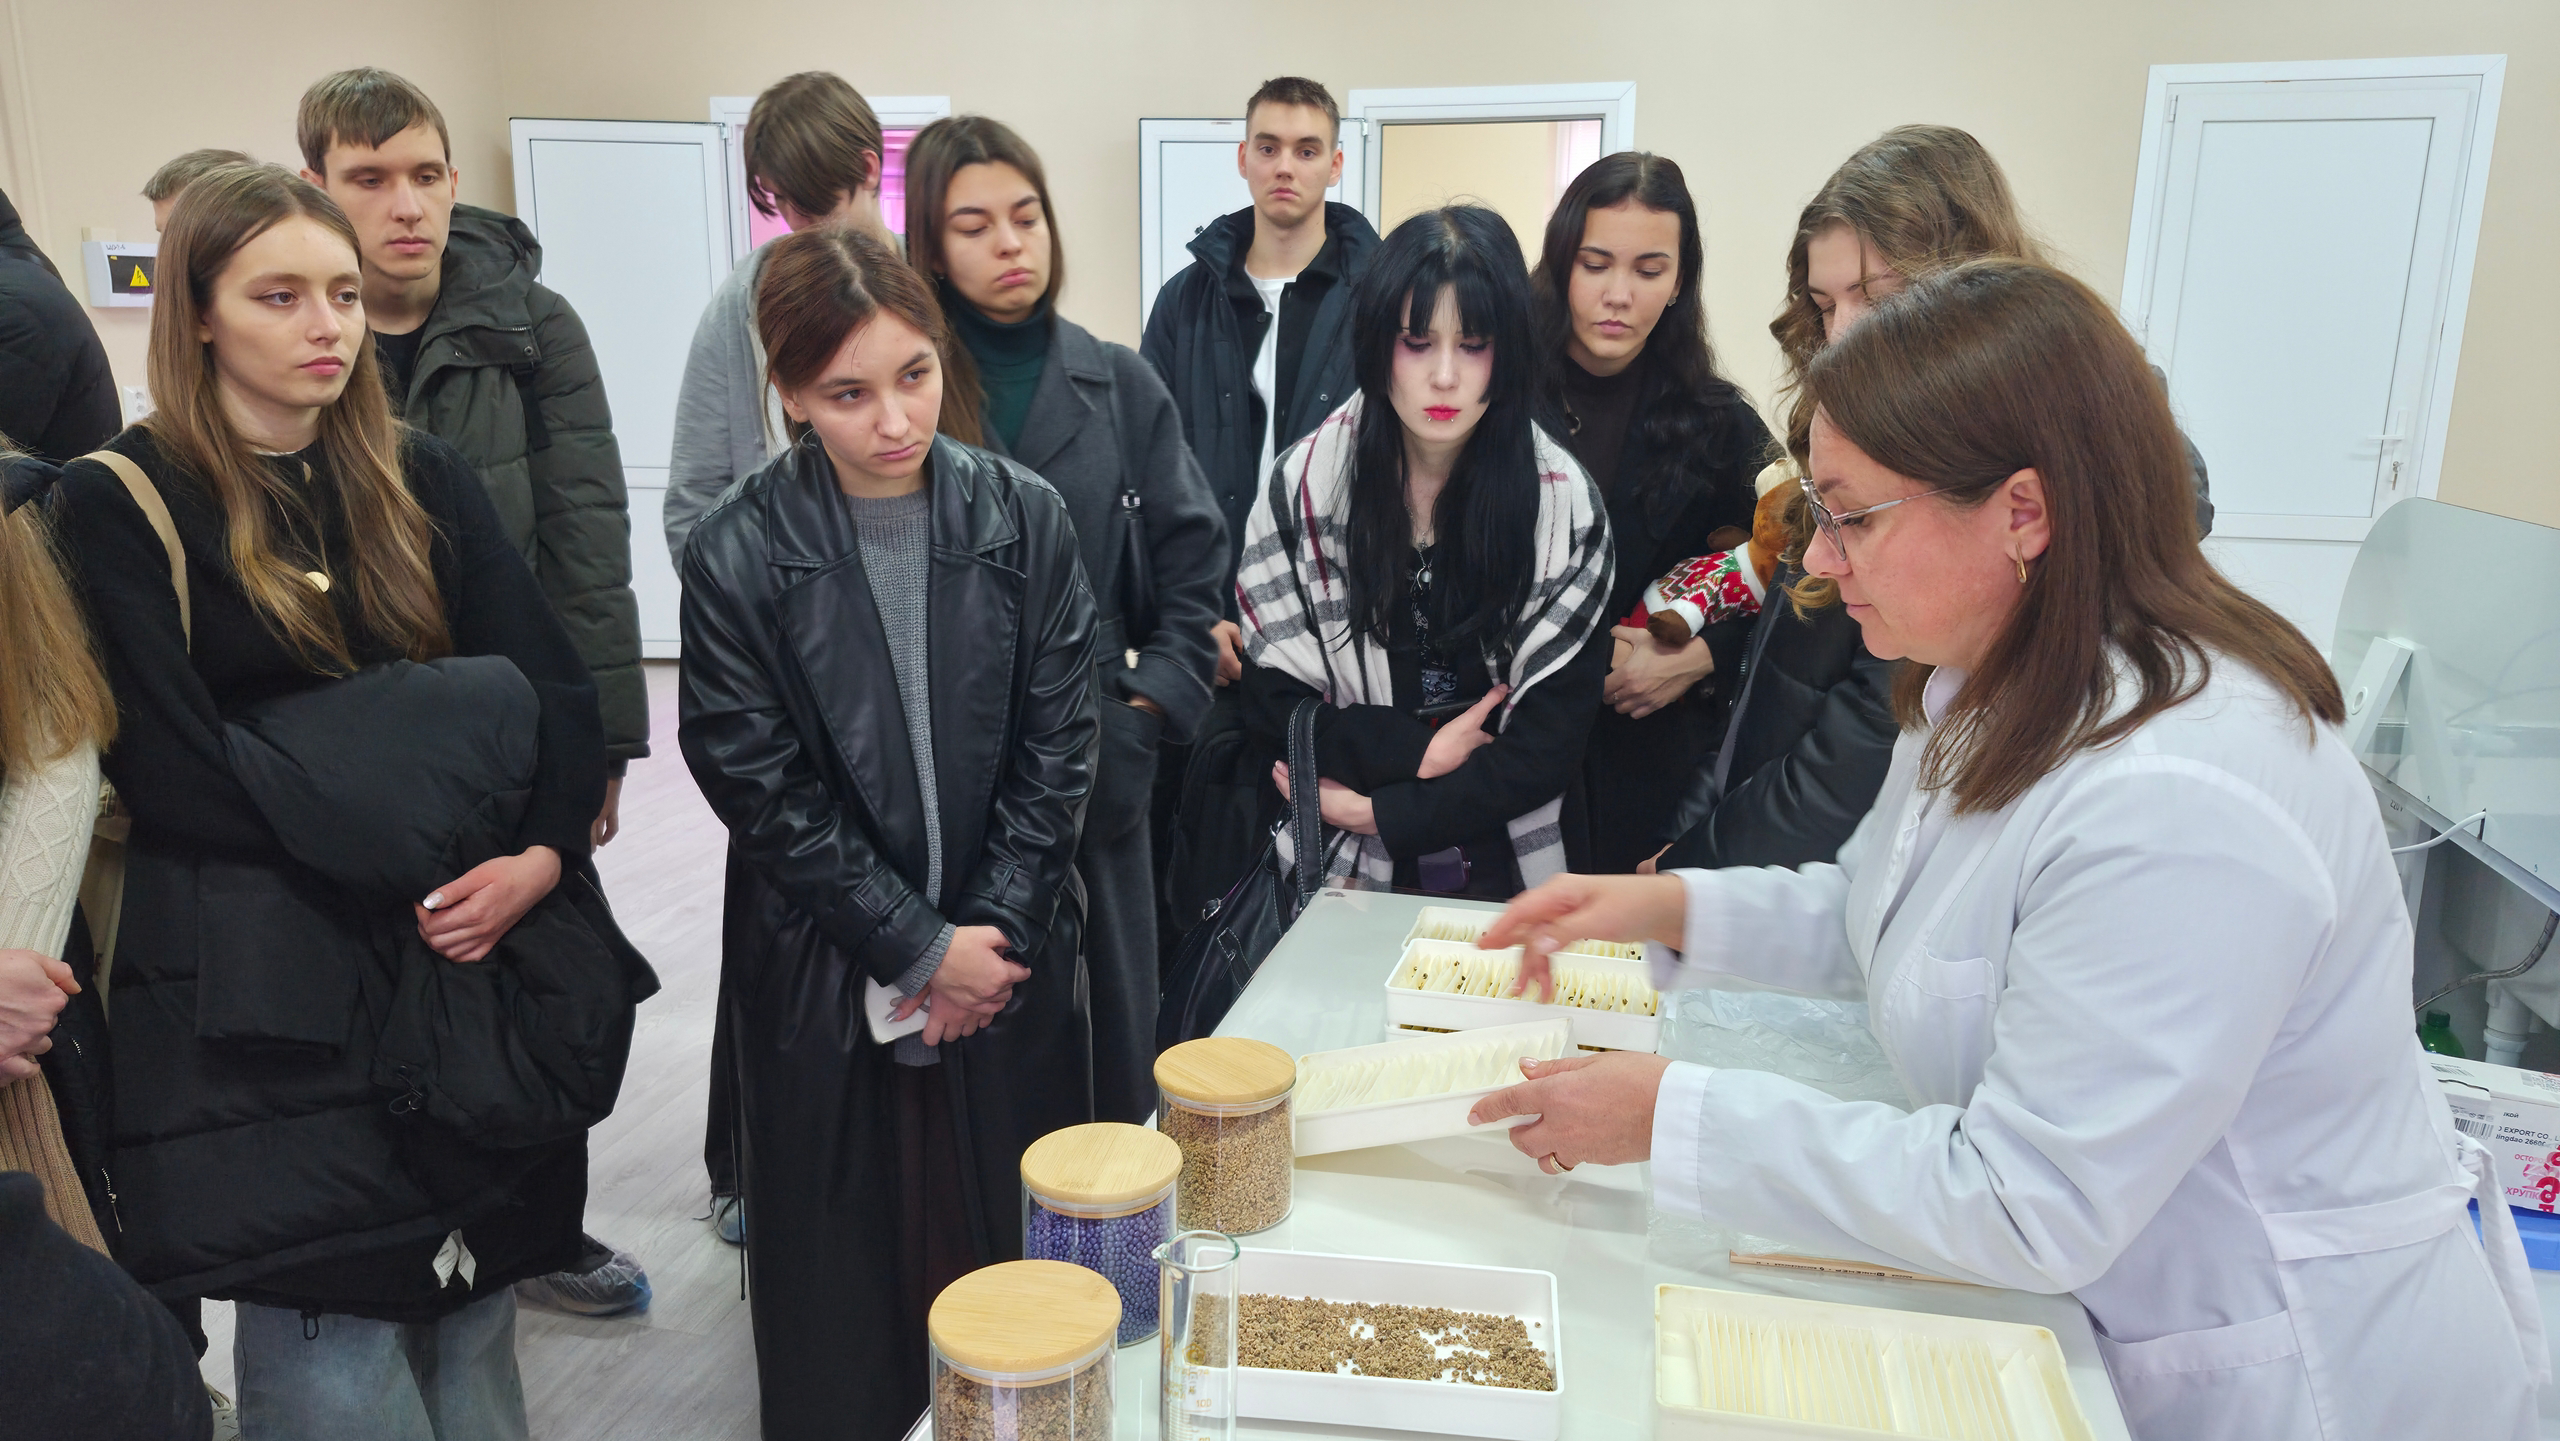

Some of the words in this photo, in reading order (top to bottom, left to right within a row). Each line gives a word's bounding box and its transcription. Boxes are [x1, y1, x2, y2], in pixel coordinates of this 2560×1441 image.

[2503, 1126, 2535, 1138] EXPORT
[2505, 1187, 2542, 1201] ХРУПК
[1196, 1398, 1212, 1408] 100
